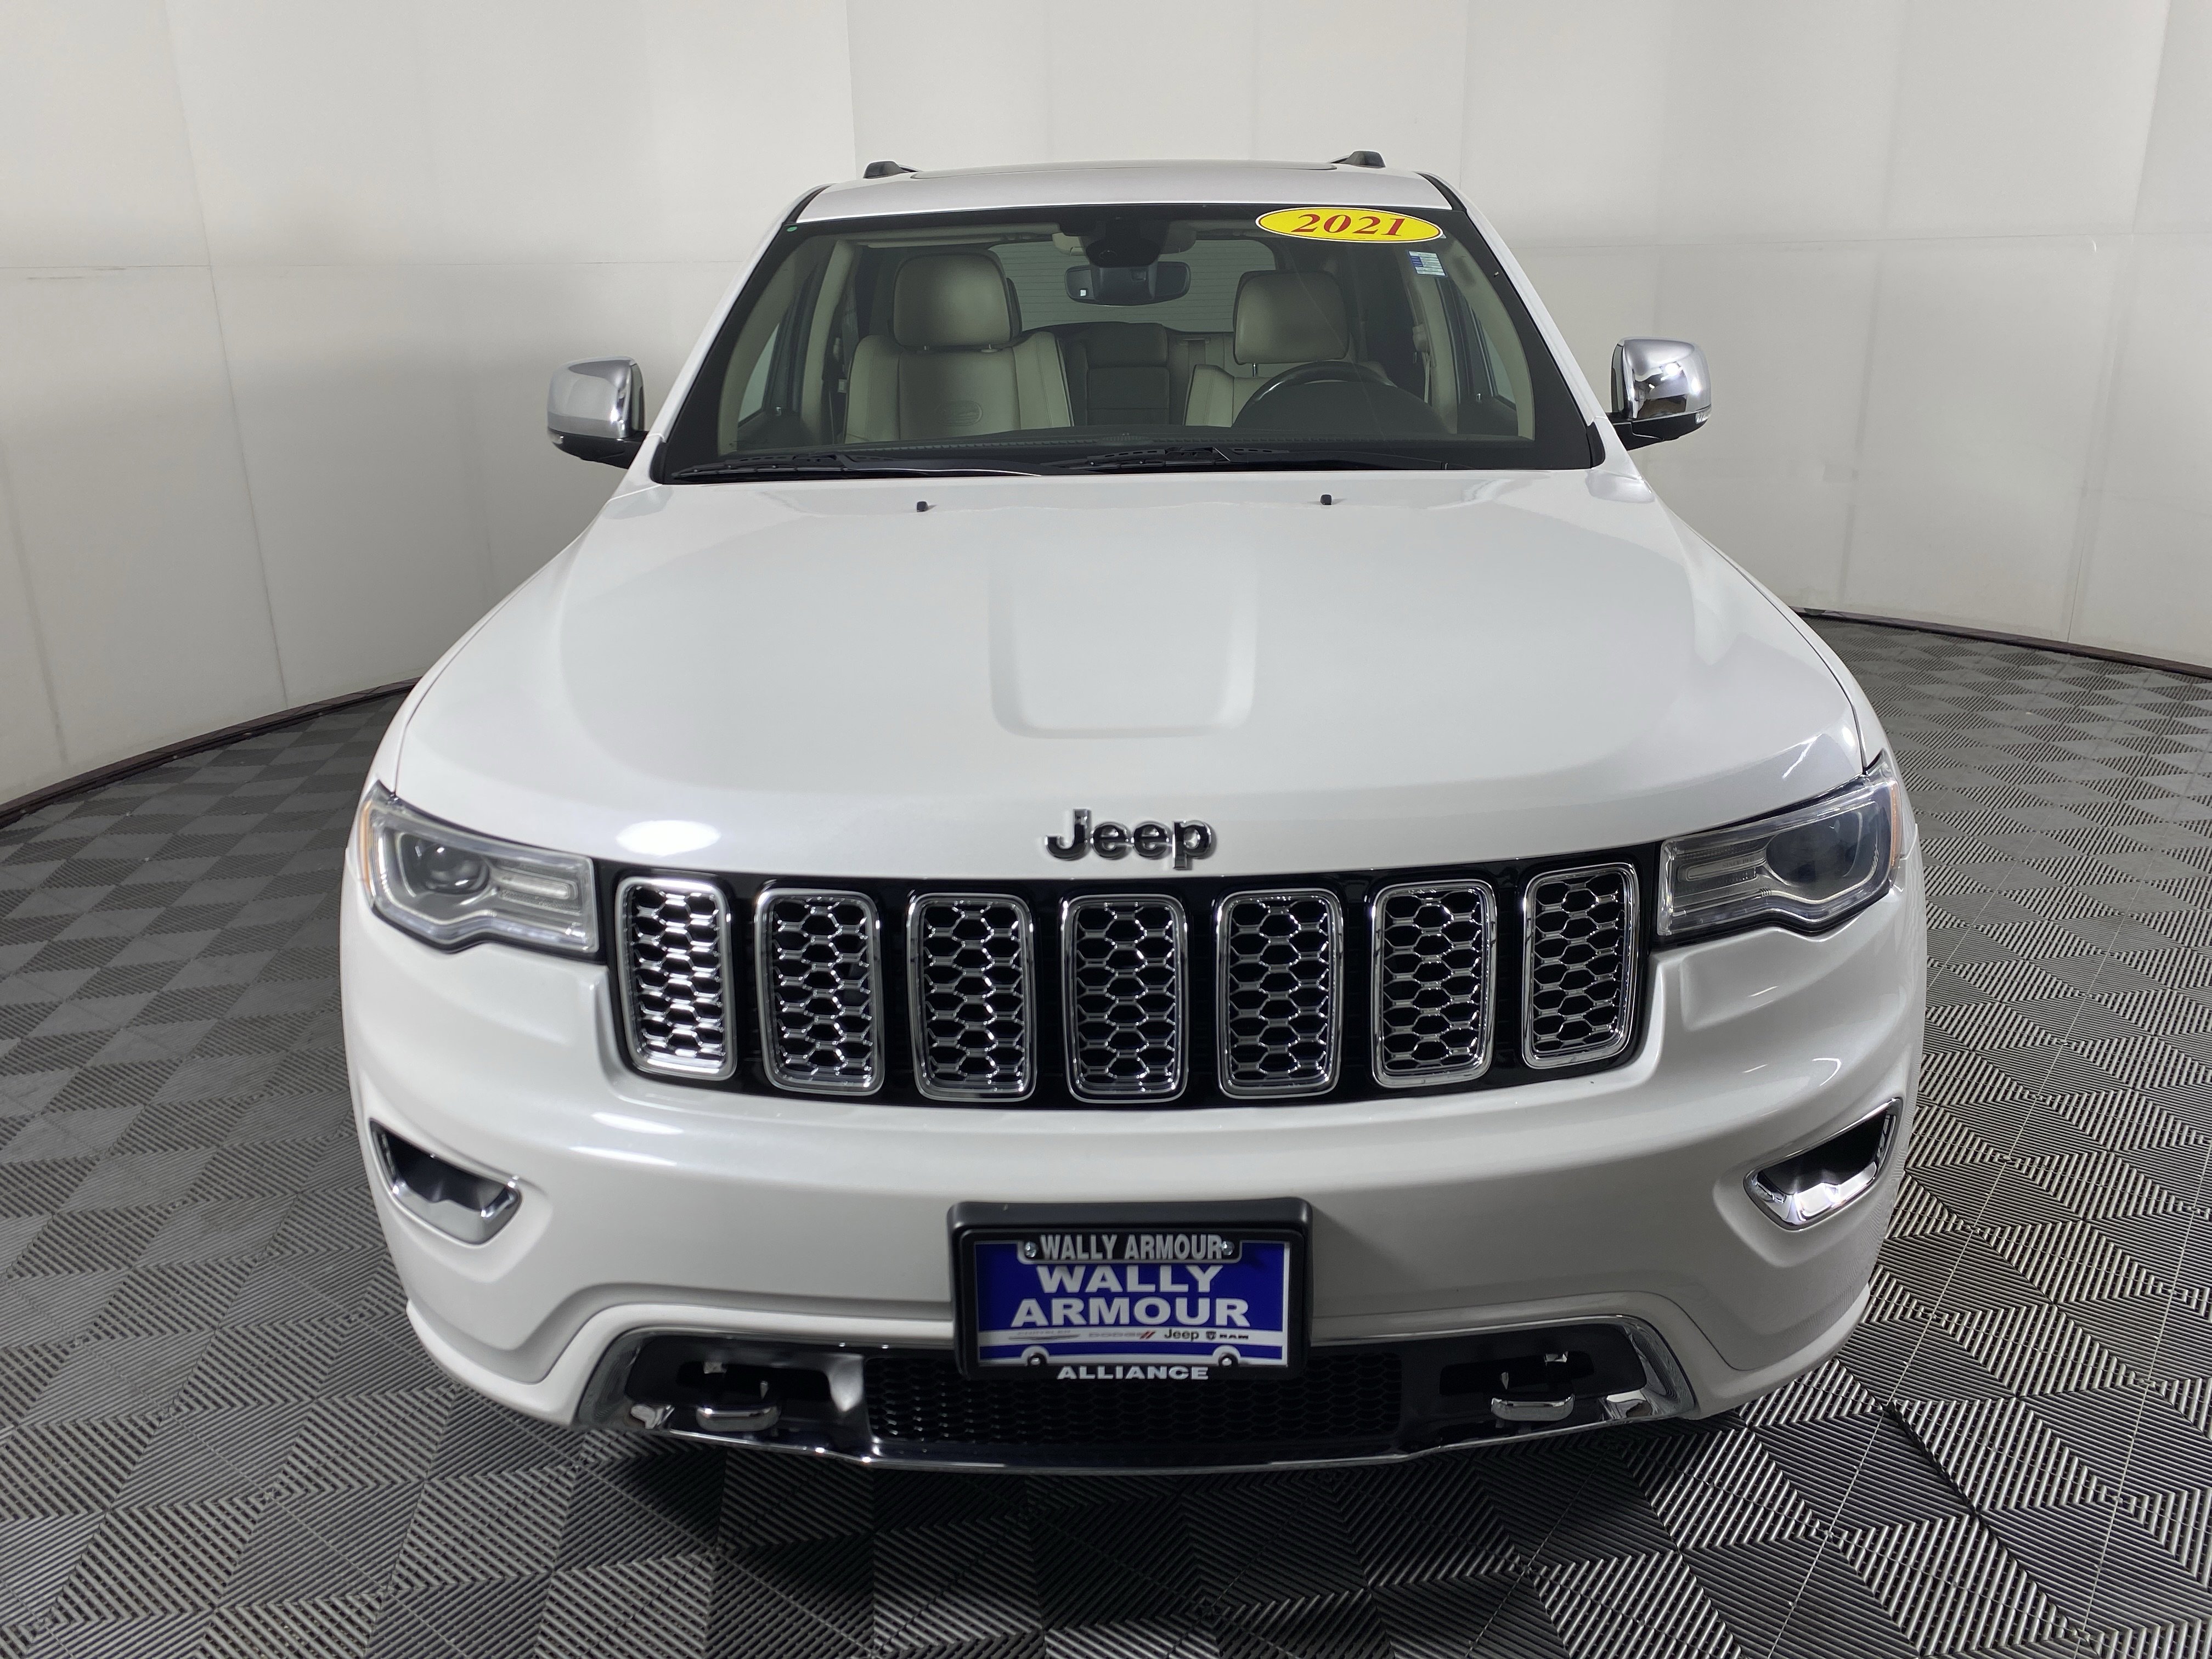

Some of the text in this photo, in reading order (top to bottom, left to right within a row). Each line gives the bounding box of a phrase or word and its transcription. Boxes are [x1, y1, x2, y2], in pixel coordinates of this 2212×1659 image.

[1291, 213, 1406, 236] 2021
[1044, 808, 1215, 870] Jeep
[1040, 1233, 1222, 1260] WALLY ARMOUR
[1036, 1264, 1223, 1294] WALLY
[1010, 1296, 1251, 1328] ARMOUR
[1164, 1328, 1199, 1342] Jeep
[1057, 1365, 1209, 1380] ALLIANCE
